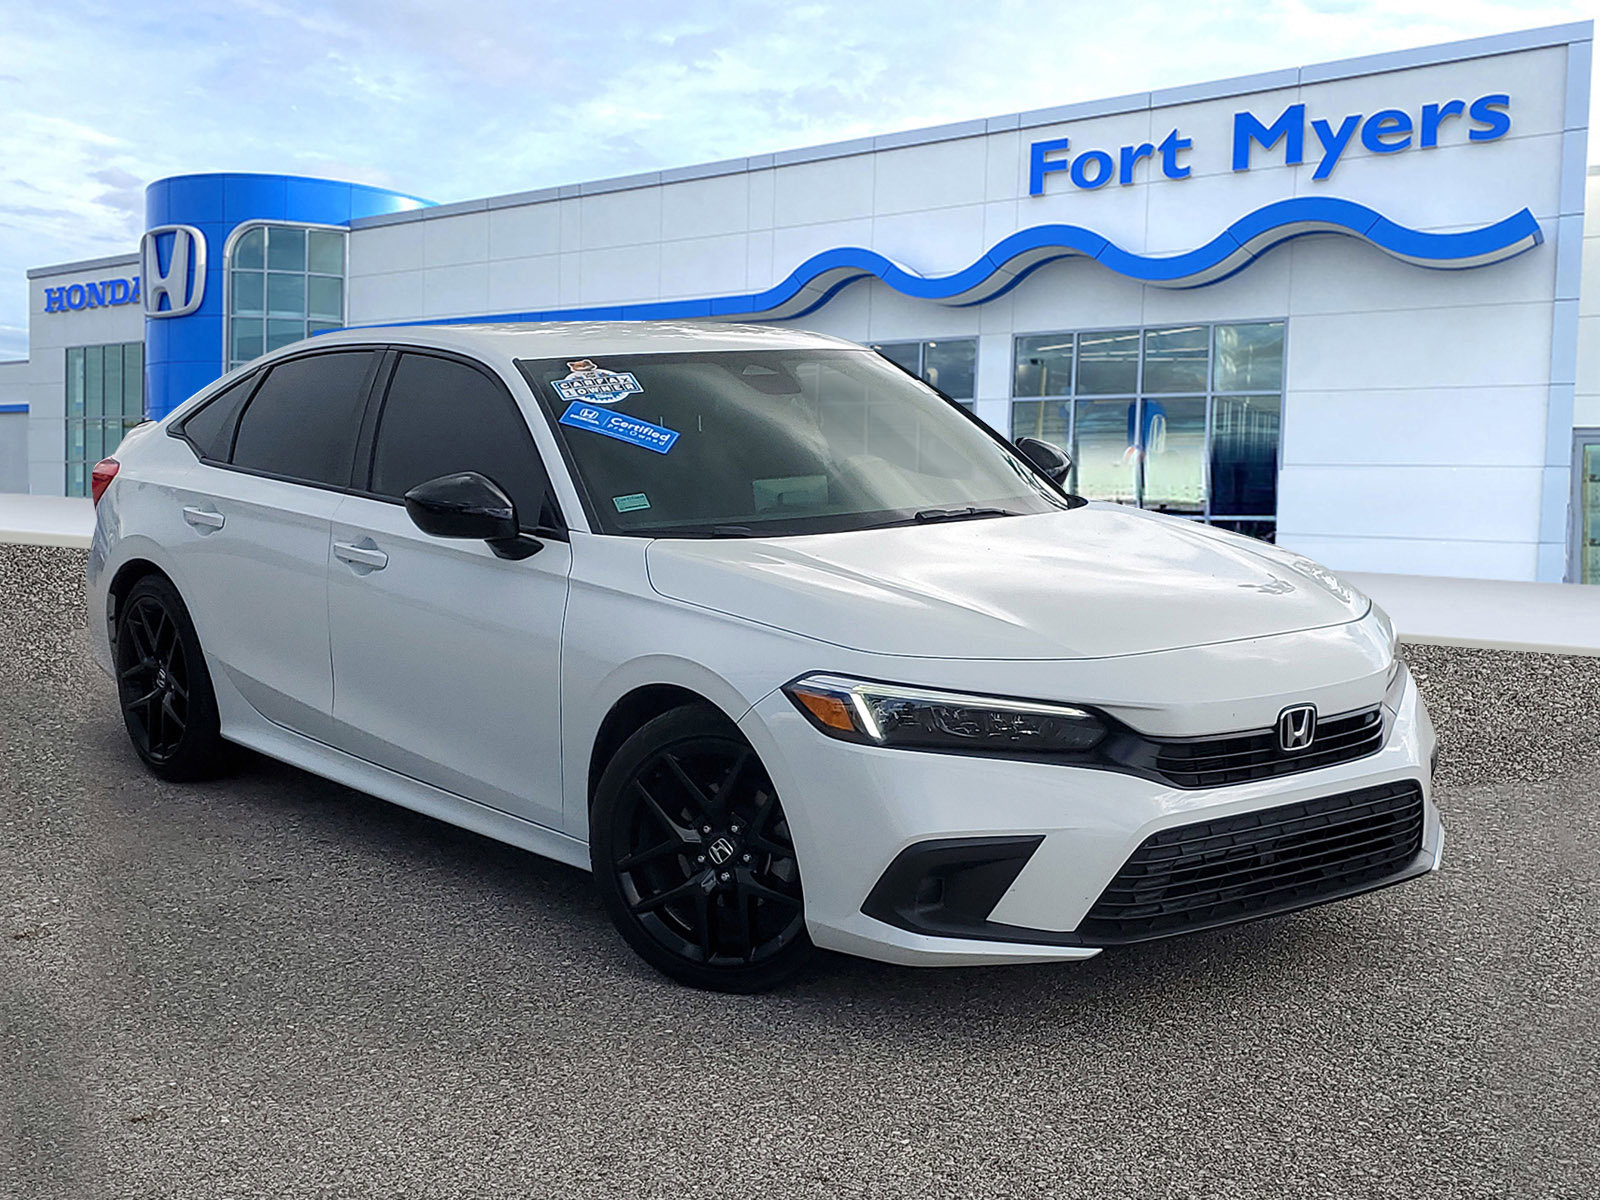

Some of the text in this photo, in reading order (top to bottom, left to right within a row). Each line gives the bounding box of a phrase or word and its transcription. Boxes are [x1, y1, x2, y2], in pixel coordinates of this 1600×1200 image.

[1029, 94, 1512, 197] Fort Myers
[560, 376, 630, 389] CARFAX
[577, 383, 636, 395] OWNER
[607, 423, 666, 446] Pre-Owned
[610, 417, 671, 441] Certified
